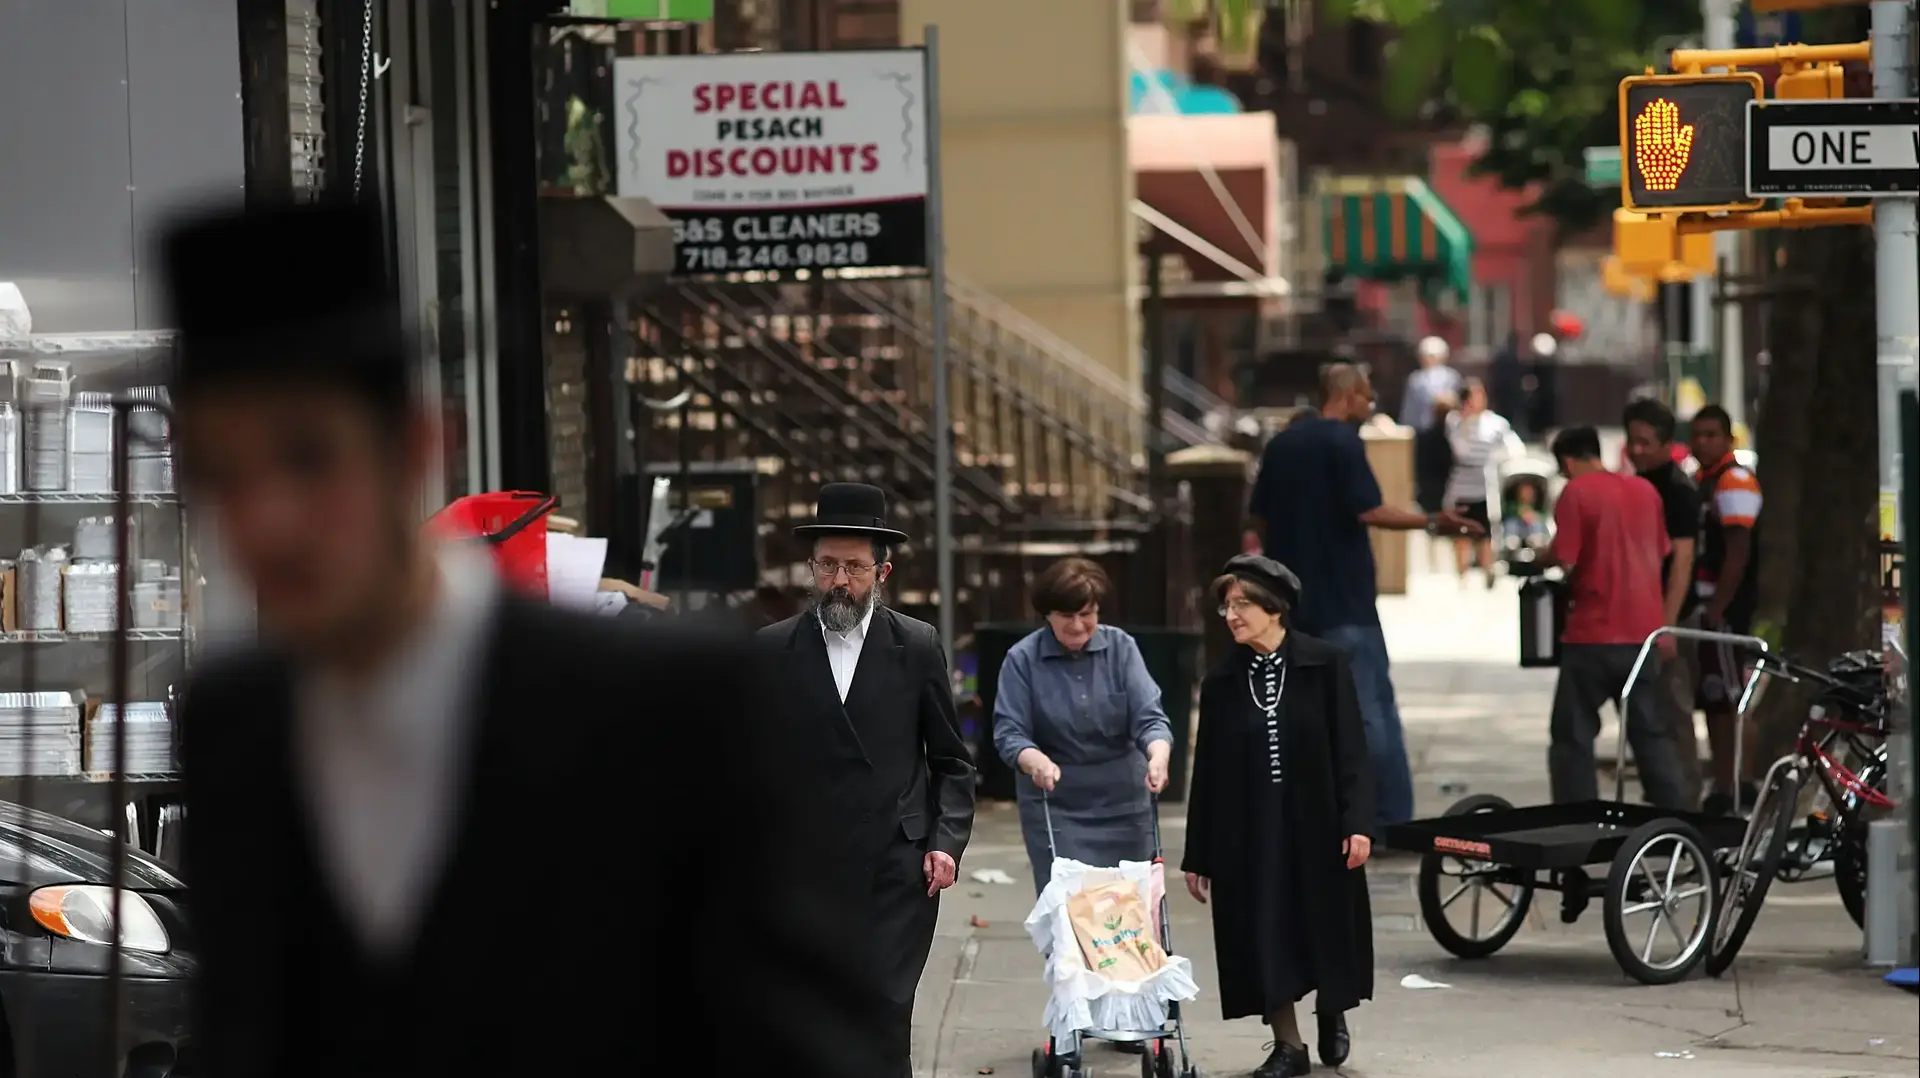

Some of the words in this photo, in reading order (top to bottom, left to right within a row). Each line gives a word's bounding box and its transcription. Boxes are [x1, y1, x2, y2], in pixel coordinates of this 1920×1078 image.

[693, 81, 847, 113] SPECIAL
[717, 117, 823, 141] PESACH
[666, 144, 880, 179] DISCOUNTS
[1792, 131, 1871, 165] ONE
[732, 212, 882, 241] CLEANERS
[682, 241, 869, 270] 718.246.9828
